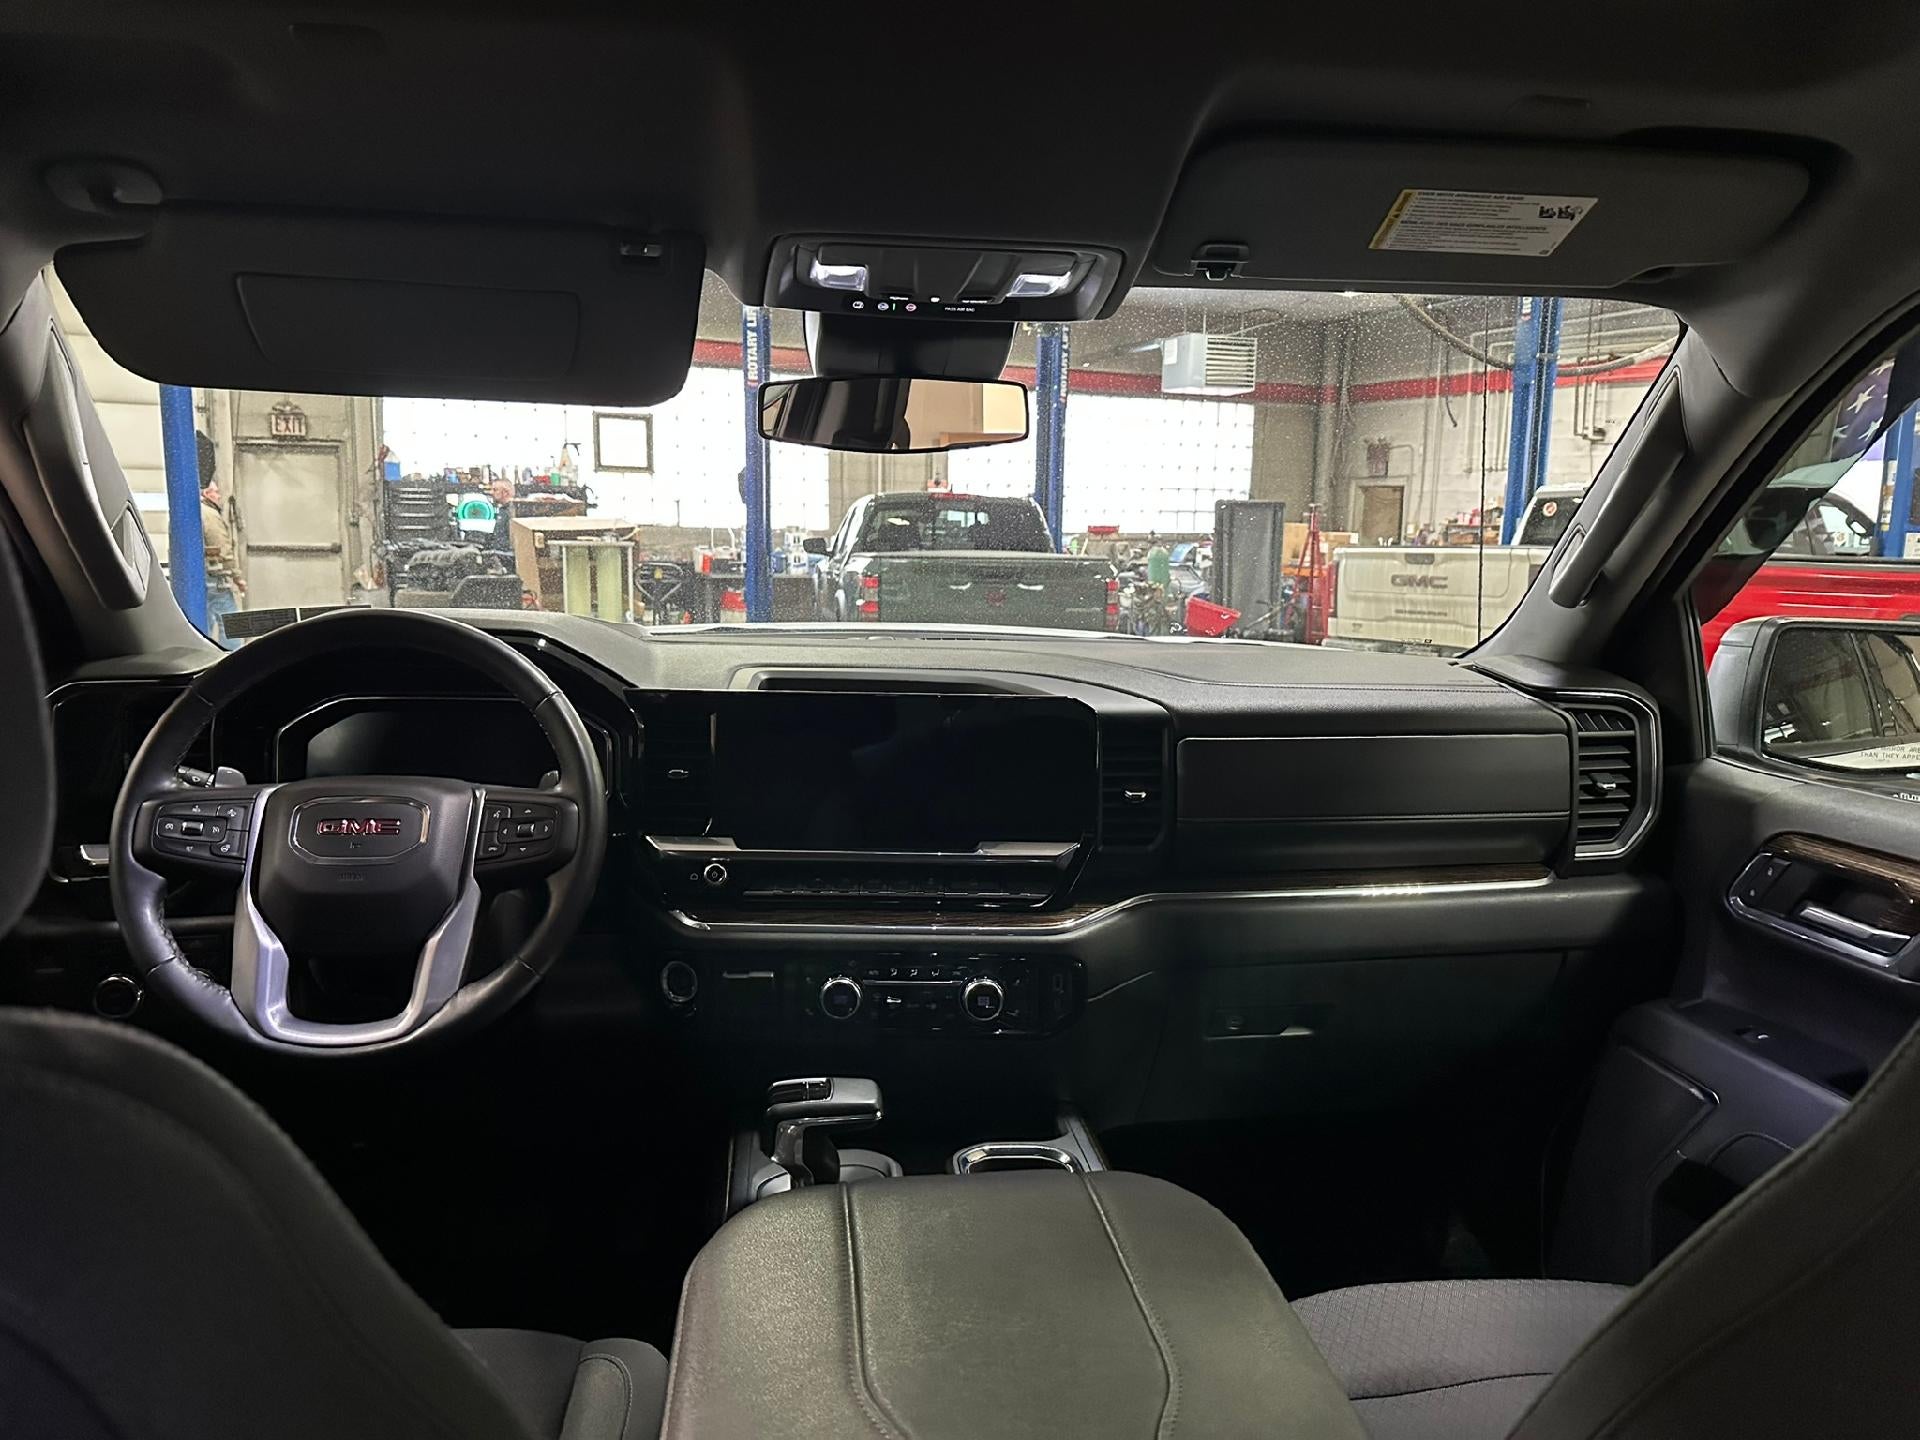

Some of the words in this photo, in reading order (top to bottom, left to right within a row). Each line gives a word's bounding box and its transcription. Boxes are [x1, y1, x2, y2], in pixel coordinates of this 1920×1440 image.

[746, 308, 757, 327] LIF
[747, 329, 758, 380] ROTARY
[275, 416, 303, 433] EXIT
[1391, 574, 1448, 589] GMC
[316, 818, 401, 835] GMC
